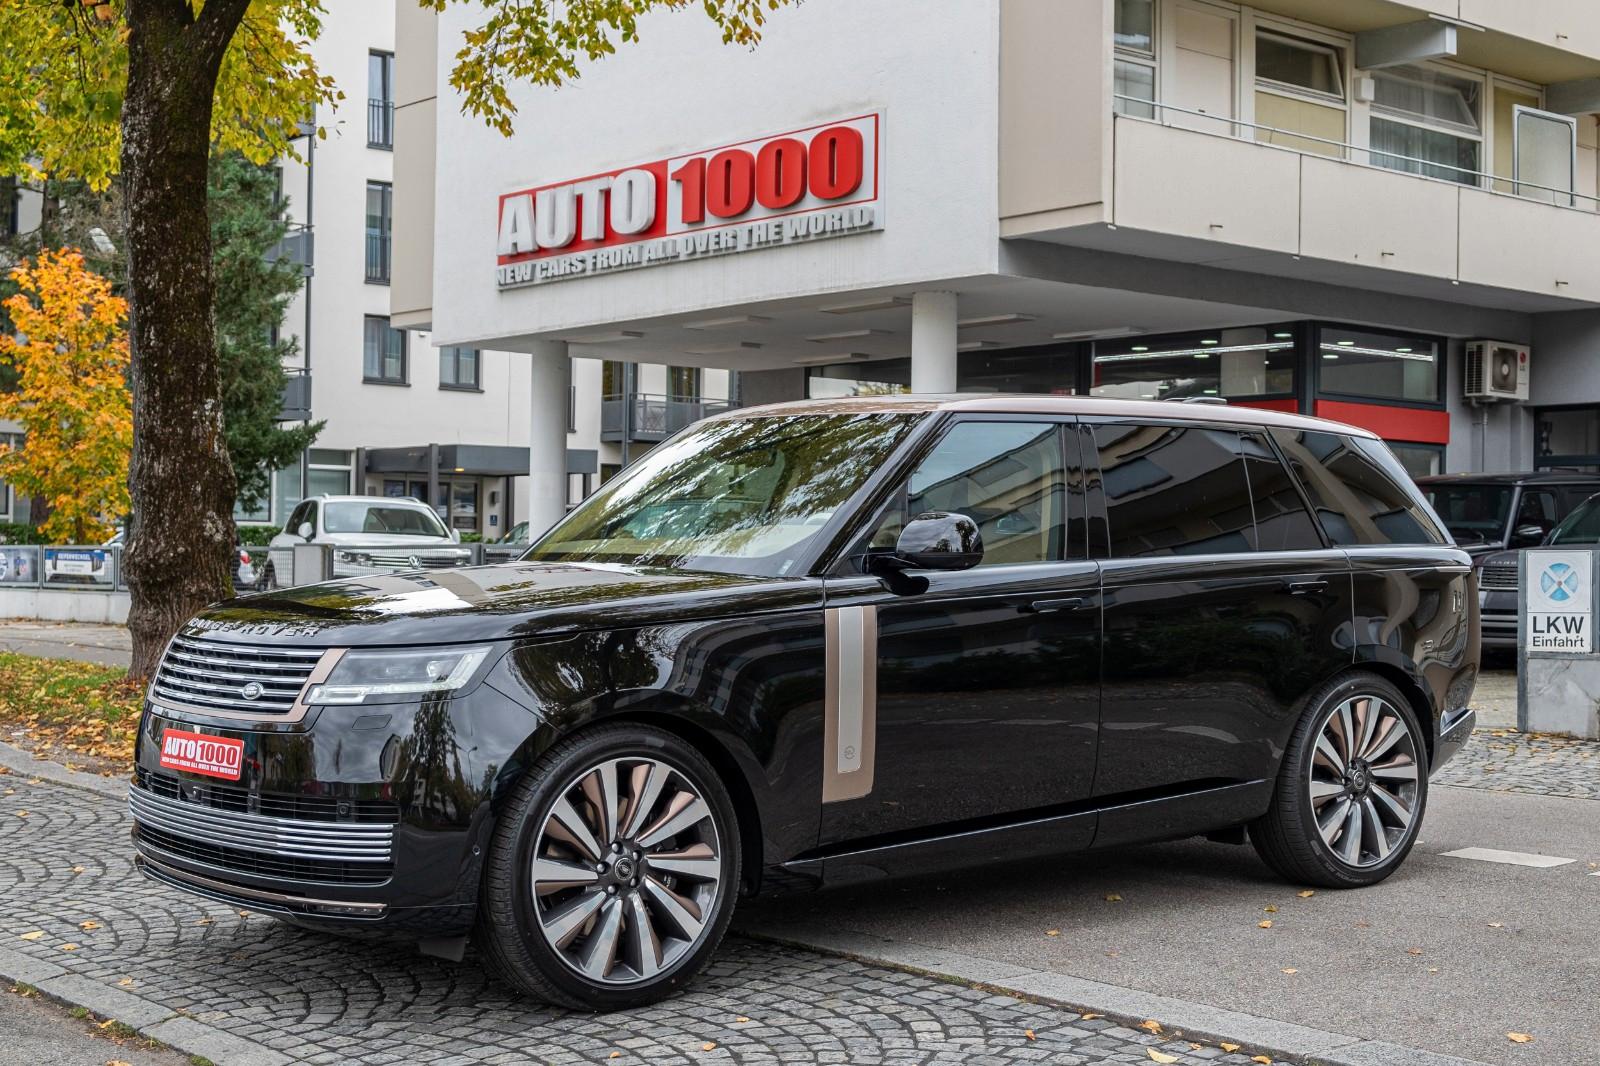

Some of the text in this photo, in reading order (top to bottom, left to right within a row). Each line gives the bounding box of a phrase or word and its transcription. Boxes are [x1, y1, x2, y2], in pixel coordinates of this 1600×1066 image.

[497, 126, 864, 256] AUTO 1000
[497, 207, 875, 285] NEW CARS FROM ALL OVER THE WORLD
[1532, 615, 1585, 634] LKW
[1532, 635, 1585, 648] Einfahrt
[164, 736, 238, 766] AUTO 1000
